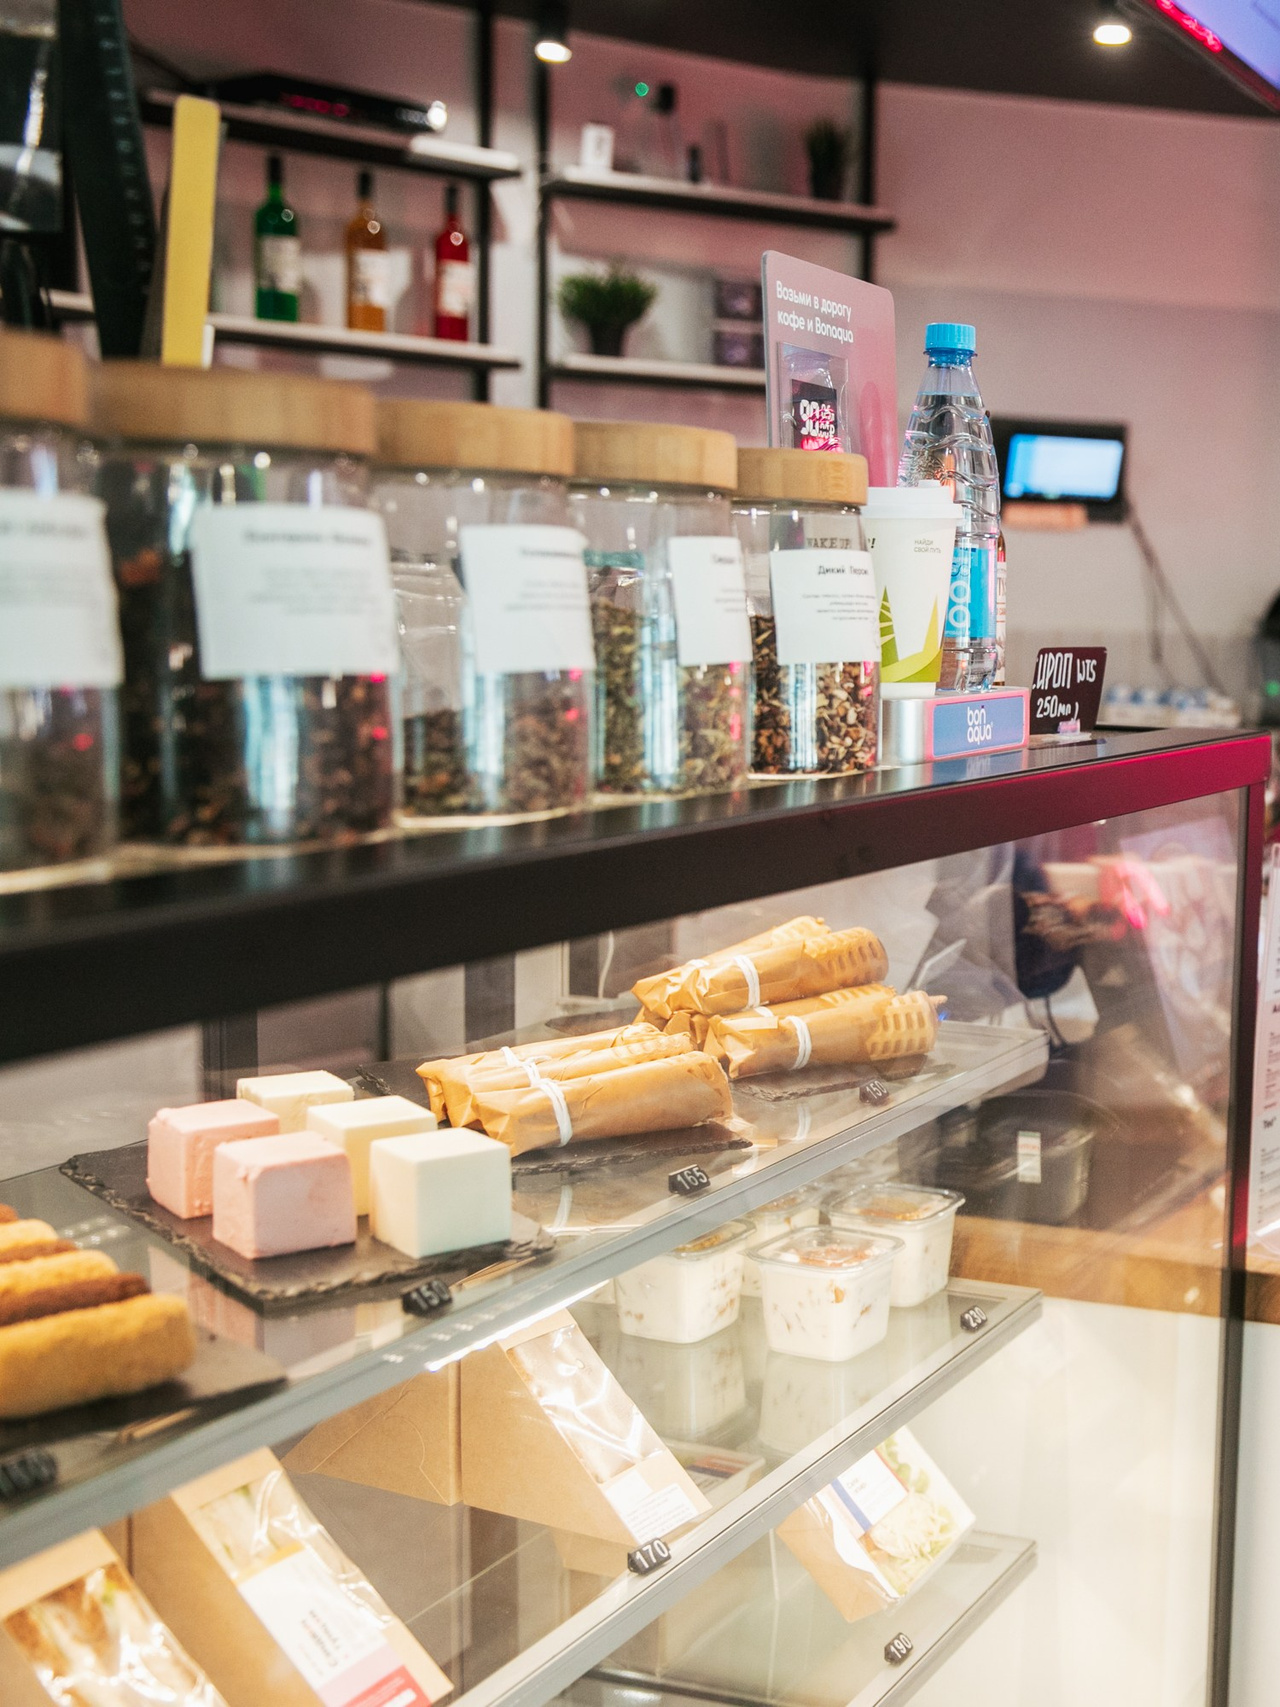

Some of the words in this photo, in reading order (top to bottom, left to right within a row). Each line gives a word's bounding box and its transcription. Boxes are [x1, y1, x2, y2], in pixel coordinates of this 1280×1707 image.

[776, 280, 812, 307] Возьми
[813, 296, 820, 309] в
[821, 299, 852, 322] дорогу
[777, 310, 805, 331] кофе
[807, 318, 814, 332] и
[815, 316, 854, 344] Bonaqua
[1032, 652, 1073, 690] ИРОП
[967, 705, 986, 726] bon
[967, 724, 992, 745] aqua
[865, 1080, 887, 1099] 150
[677, 1167, 708, 1189] 165
[411, 1280, 450, 1310] 150
[964, 1306, 987, 1328] 230
[635, 1539, 669, 1569] 170
[890, 1634, 912, 1659] 190
